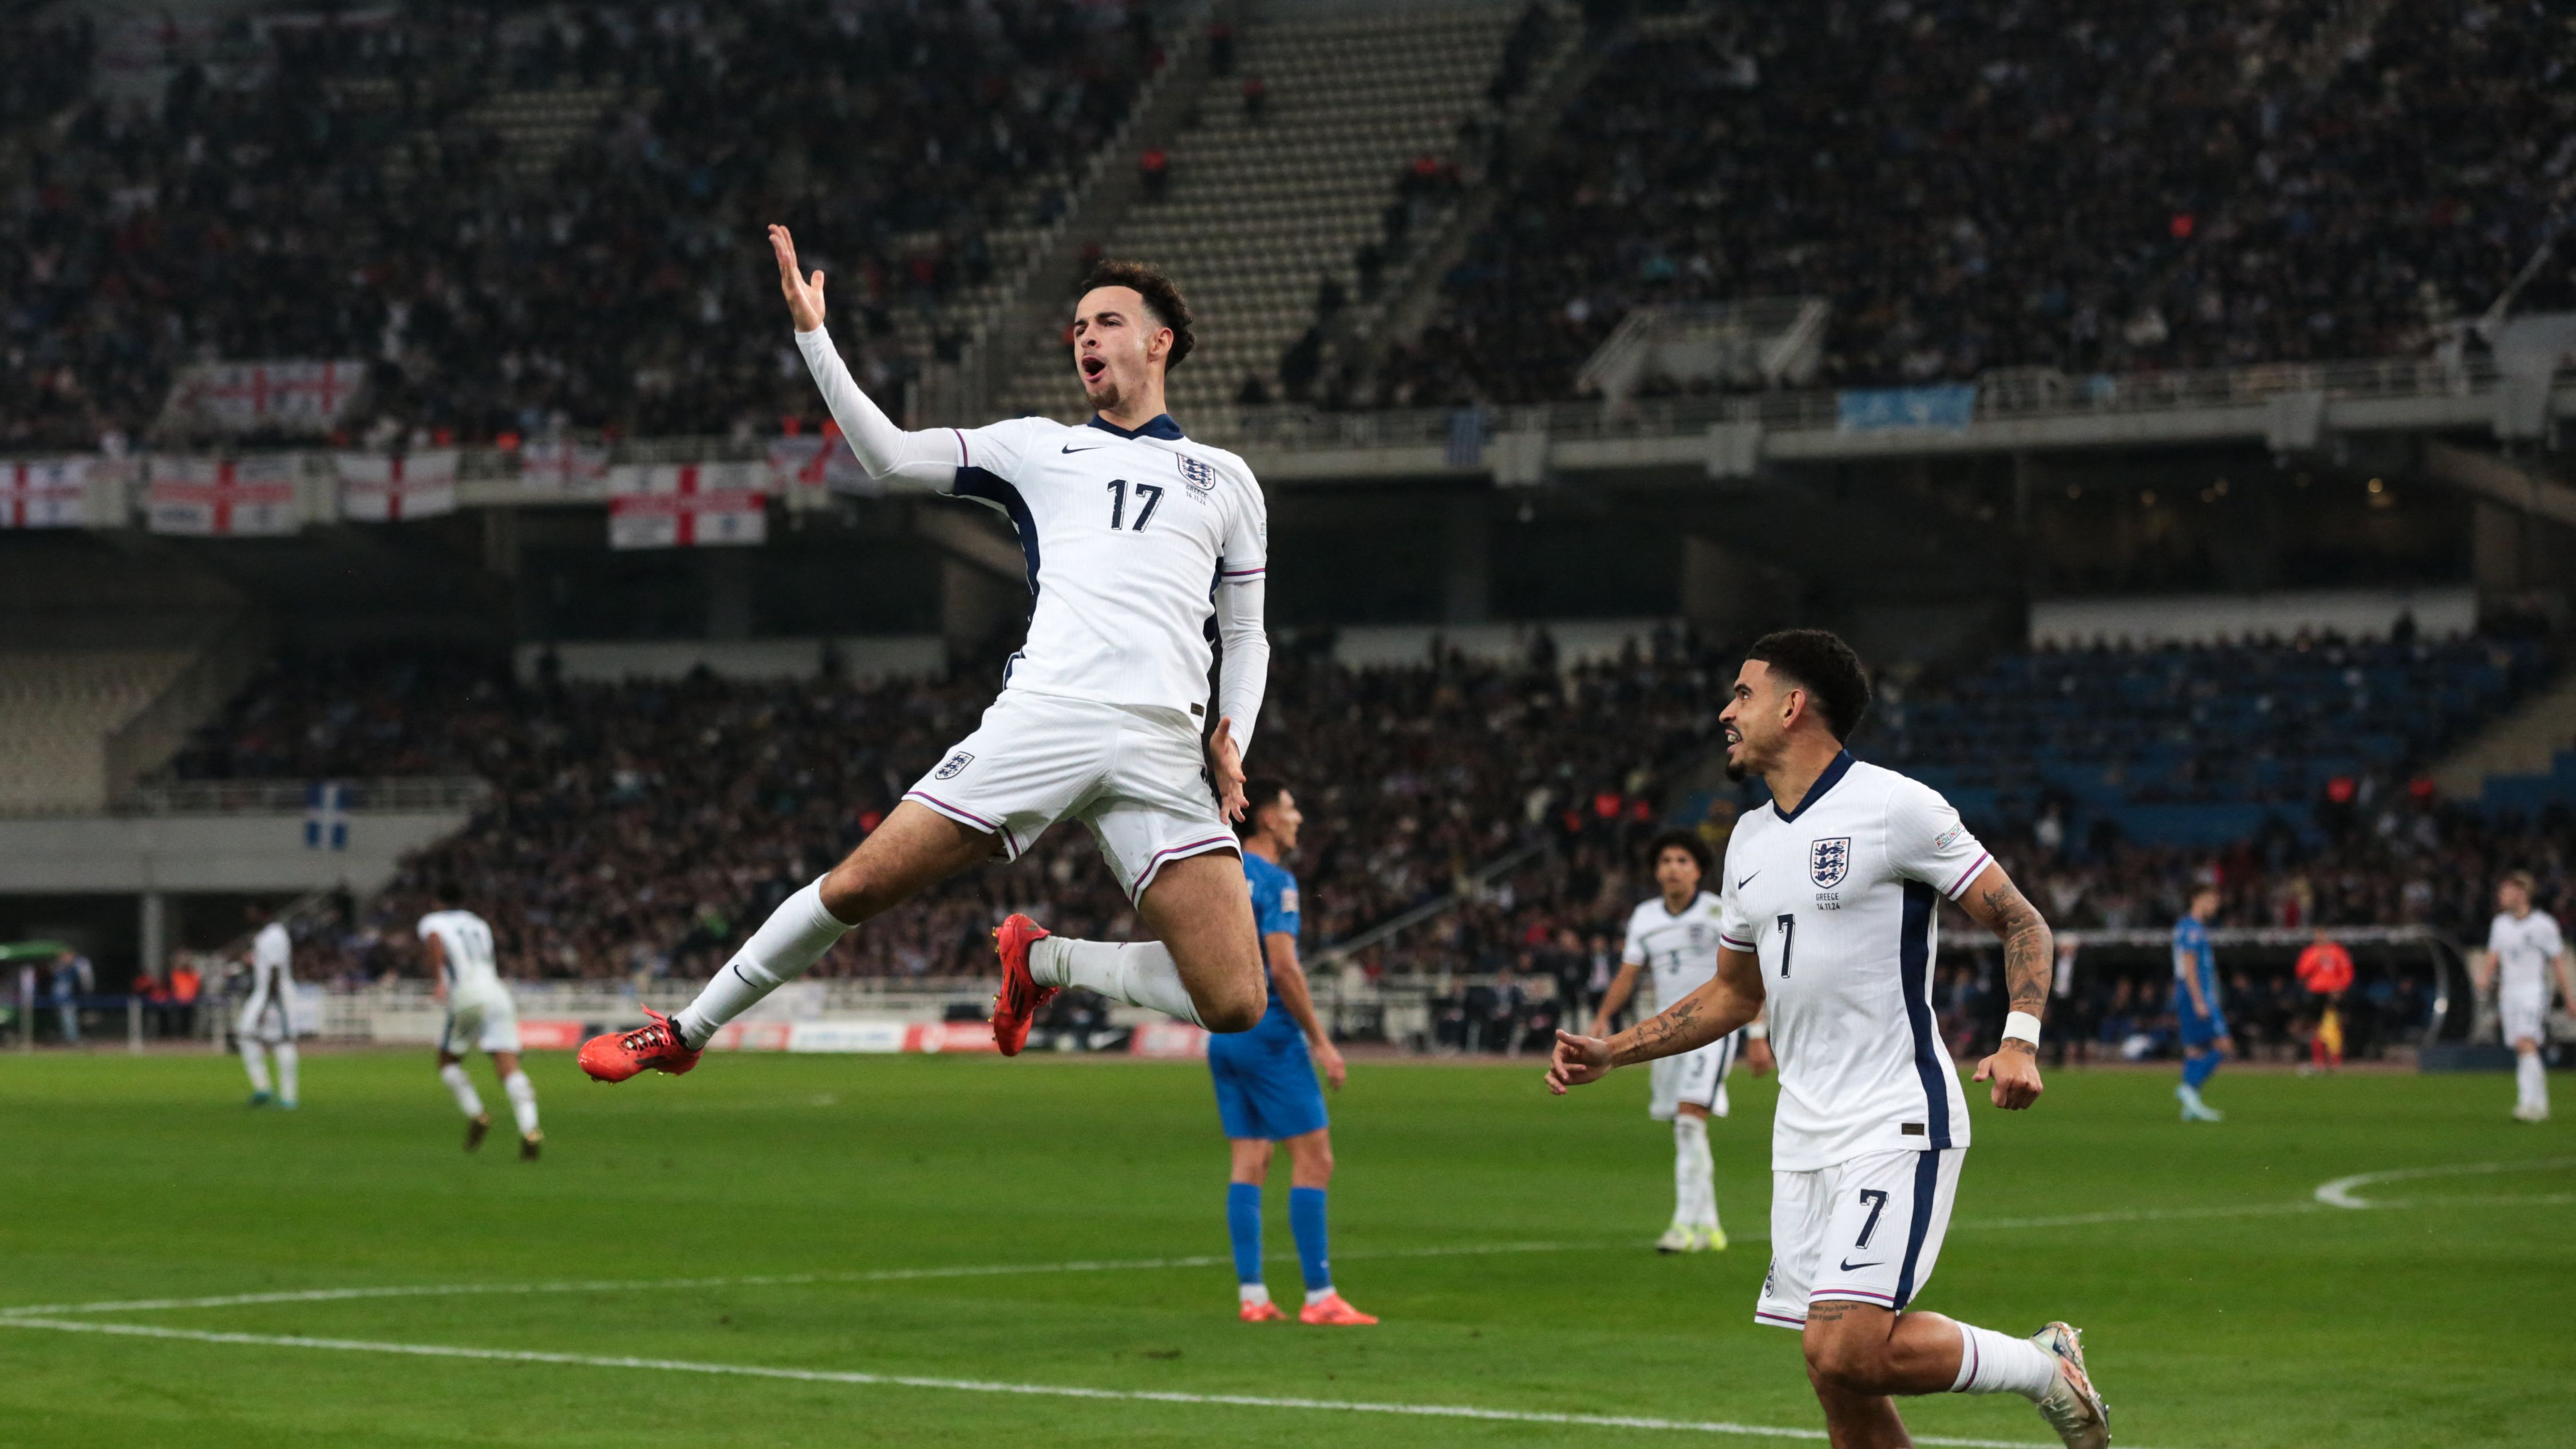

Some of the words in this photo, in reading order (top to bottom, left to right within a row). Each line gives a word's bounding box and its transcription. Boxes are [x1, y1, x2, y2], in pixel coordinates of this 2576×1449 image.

[1186, 485, 1208, 499] GREECE
[1107, 479, 1164, 533] 17
[1816, 893, 1840, 901] GREECE
[1816, 902, 1840, 911] 14.11.24
[1777, 914, 1796, 978] 7
[1668, 948, 1681, 975] 3
[1692, 1052, 1708, 1078] 3
[1855, 1189, 1889, 1249] 7
